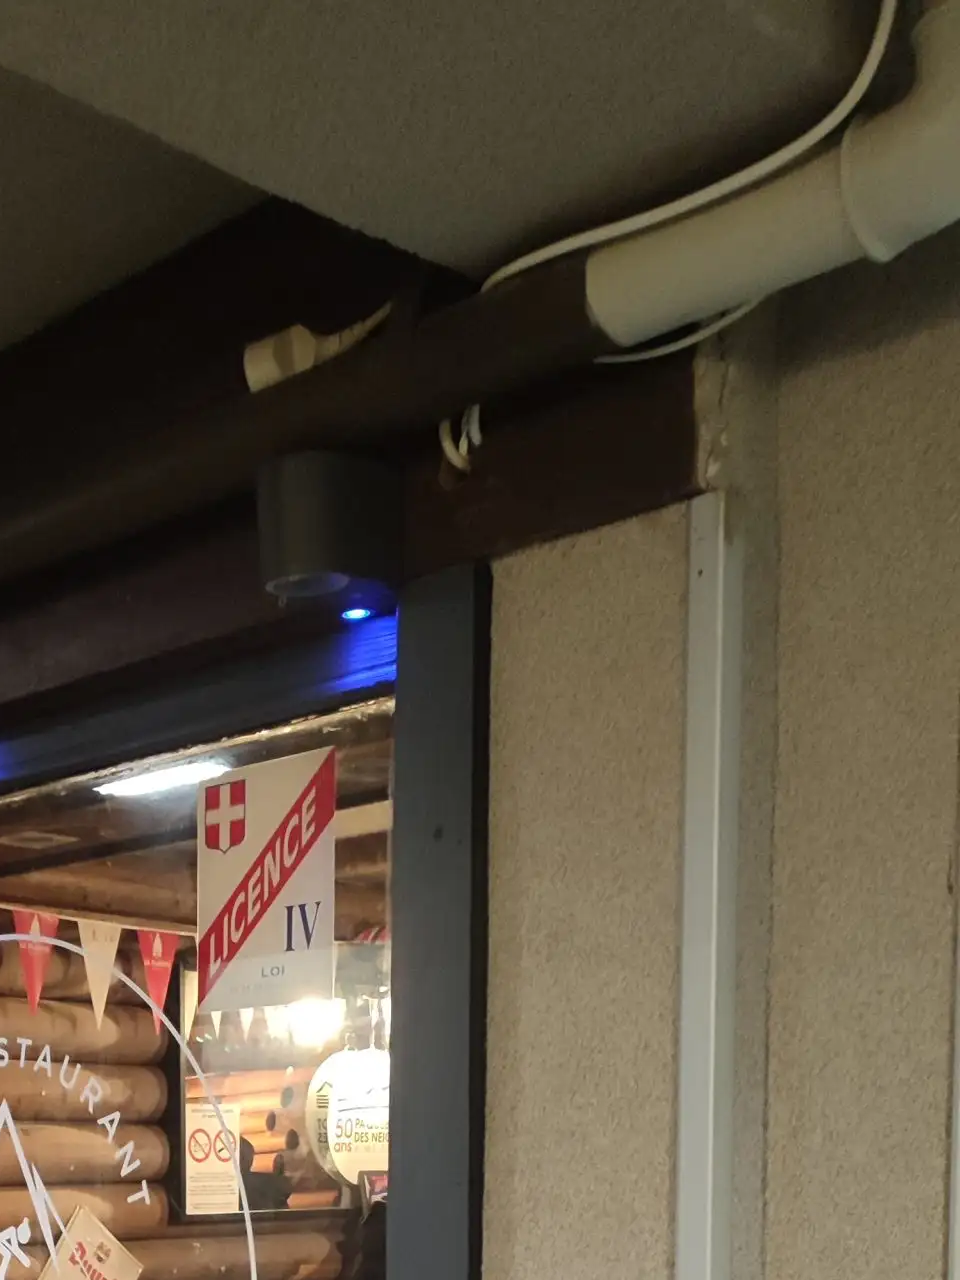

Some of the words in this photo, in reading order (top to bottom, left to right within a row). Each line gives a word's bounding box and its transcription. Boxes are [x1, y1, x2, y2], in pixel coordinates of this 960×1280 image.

[207, 785, 316, 979] LICENCE
[283, 901, 321, 952] IV
[261, 965, 285, 978] LOI
[335, 1118, 353, 1139] 50
[354, 1132, 369, 1143] DES
